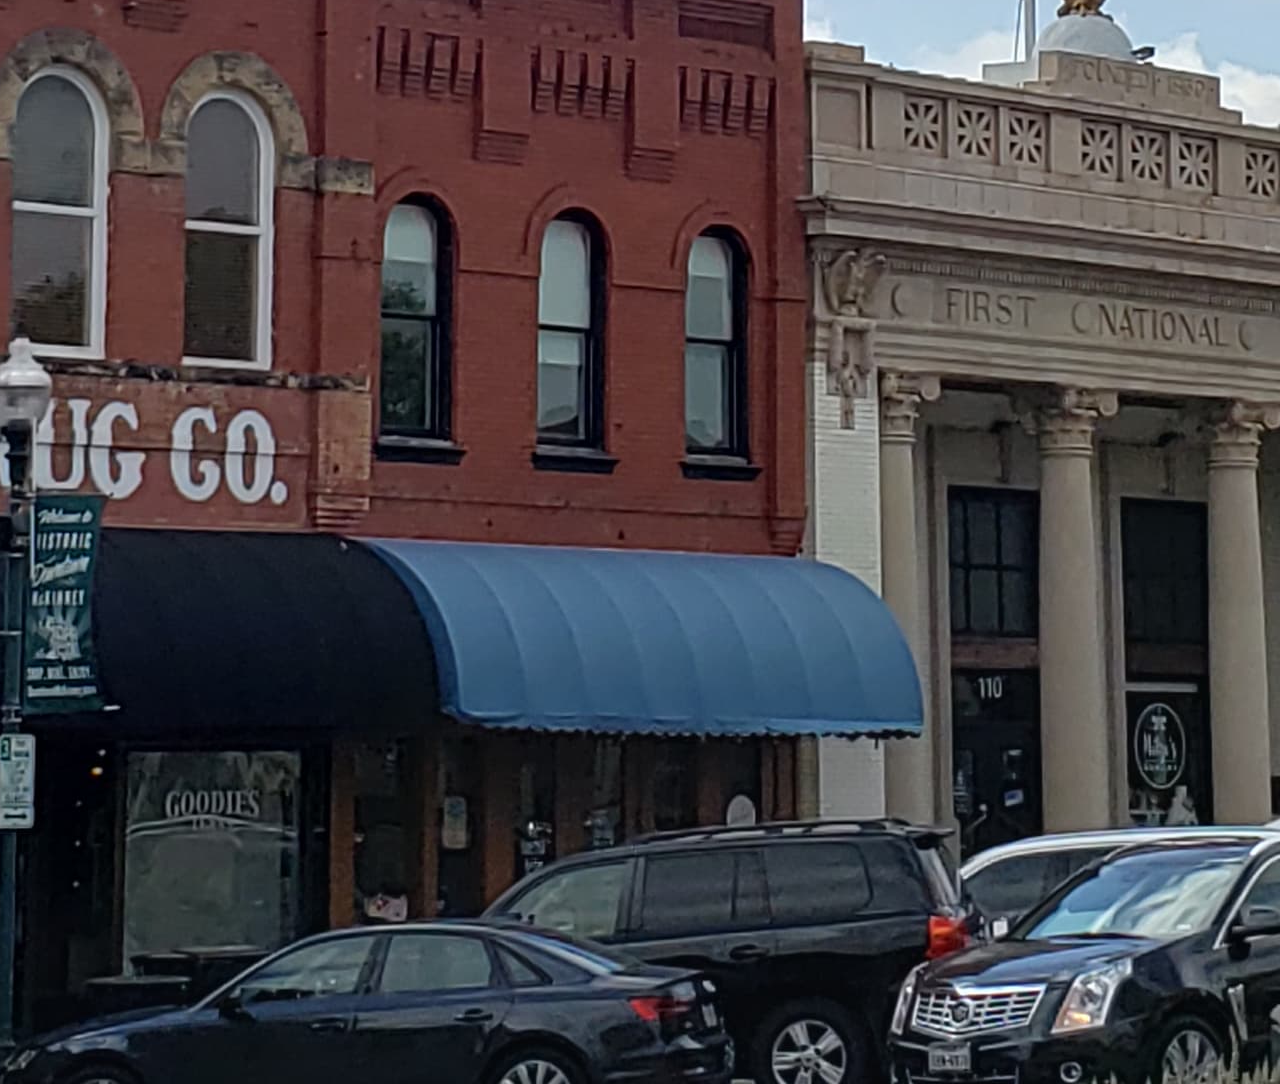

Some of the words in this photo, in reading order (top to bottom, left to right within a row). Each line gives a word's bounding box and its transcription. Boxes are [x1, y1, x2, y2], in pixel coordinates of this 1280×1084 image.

[945, 288, 1037, 328] FIRST
[1098, 302, 1231, 347] NATIONAL
[169, 406, 288, 506] CO.
[978, 676, 1003, 699] 110
[165, 789, 260, 820] GOODIES
